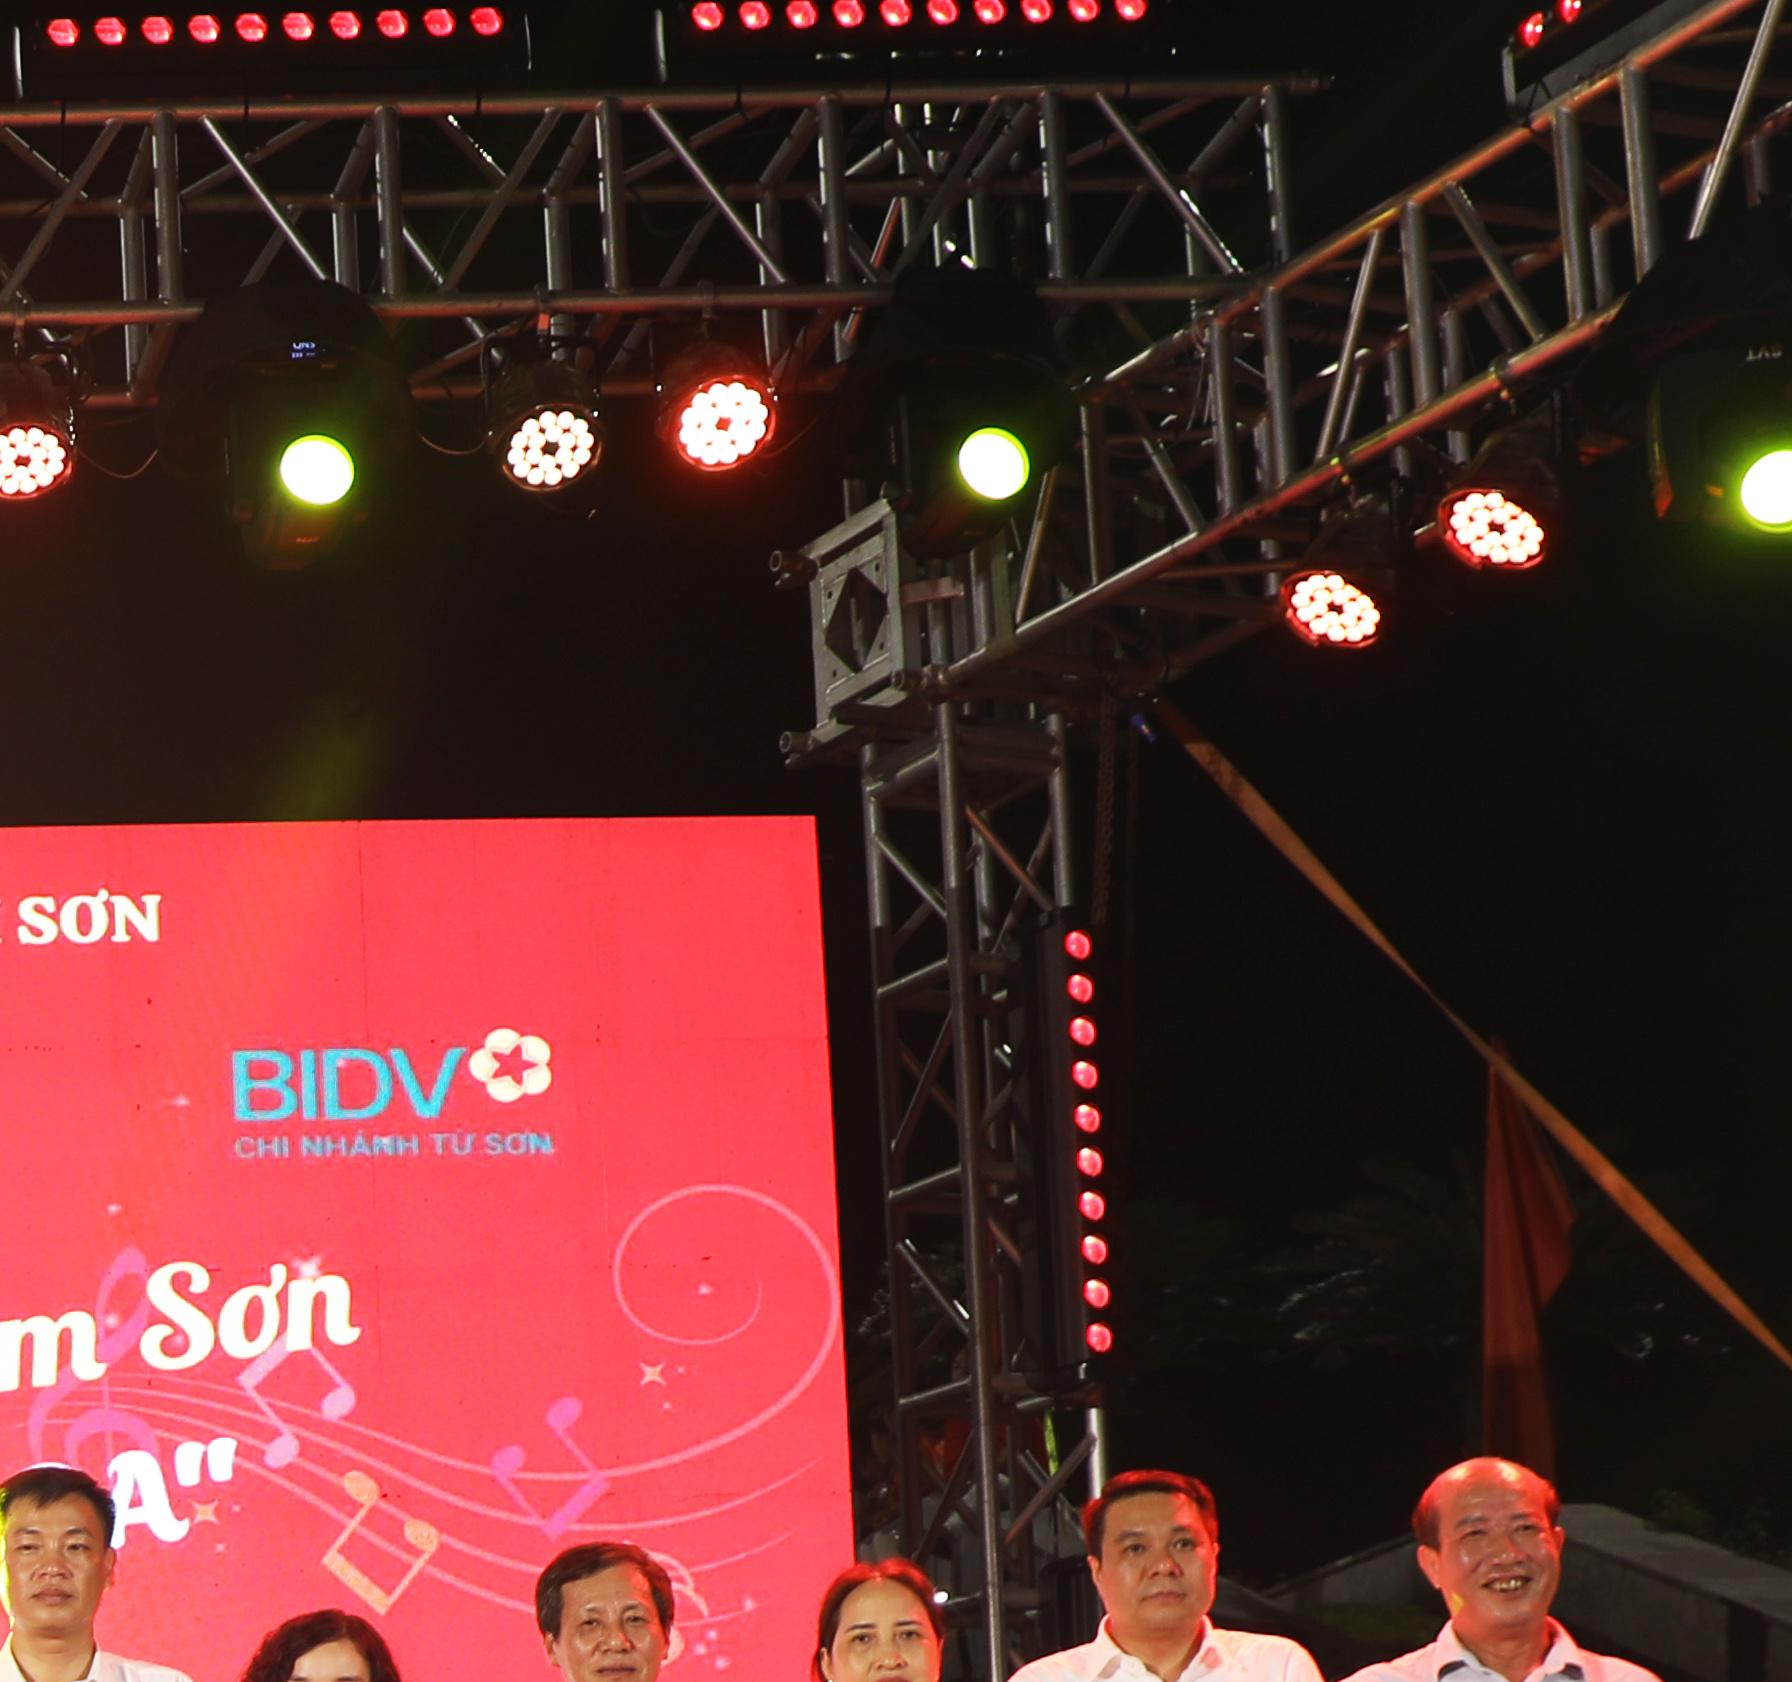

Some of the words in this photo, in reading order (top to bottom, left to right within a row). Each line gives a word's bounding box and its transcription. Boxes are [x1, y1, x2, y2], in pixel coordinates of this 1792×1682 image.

[16, 891, 162, 946] SƠN
[231, 1047, 467, 1121] BIDV
[235, 1136, 289, 1158] CHI
[301, 1130, 418, 1157] NHÁNH
[430, 1129, 475, 1156] TỪ
[484, 1131, 554, 1156] SƠN
[139, 1261, 361, 1370] Sơn
